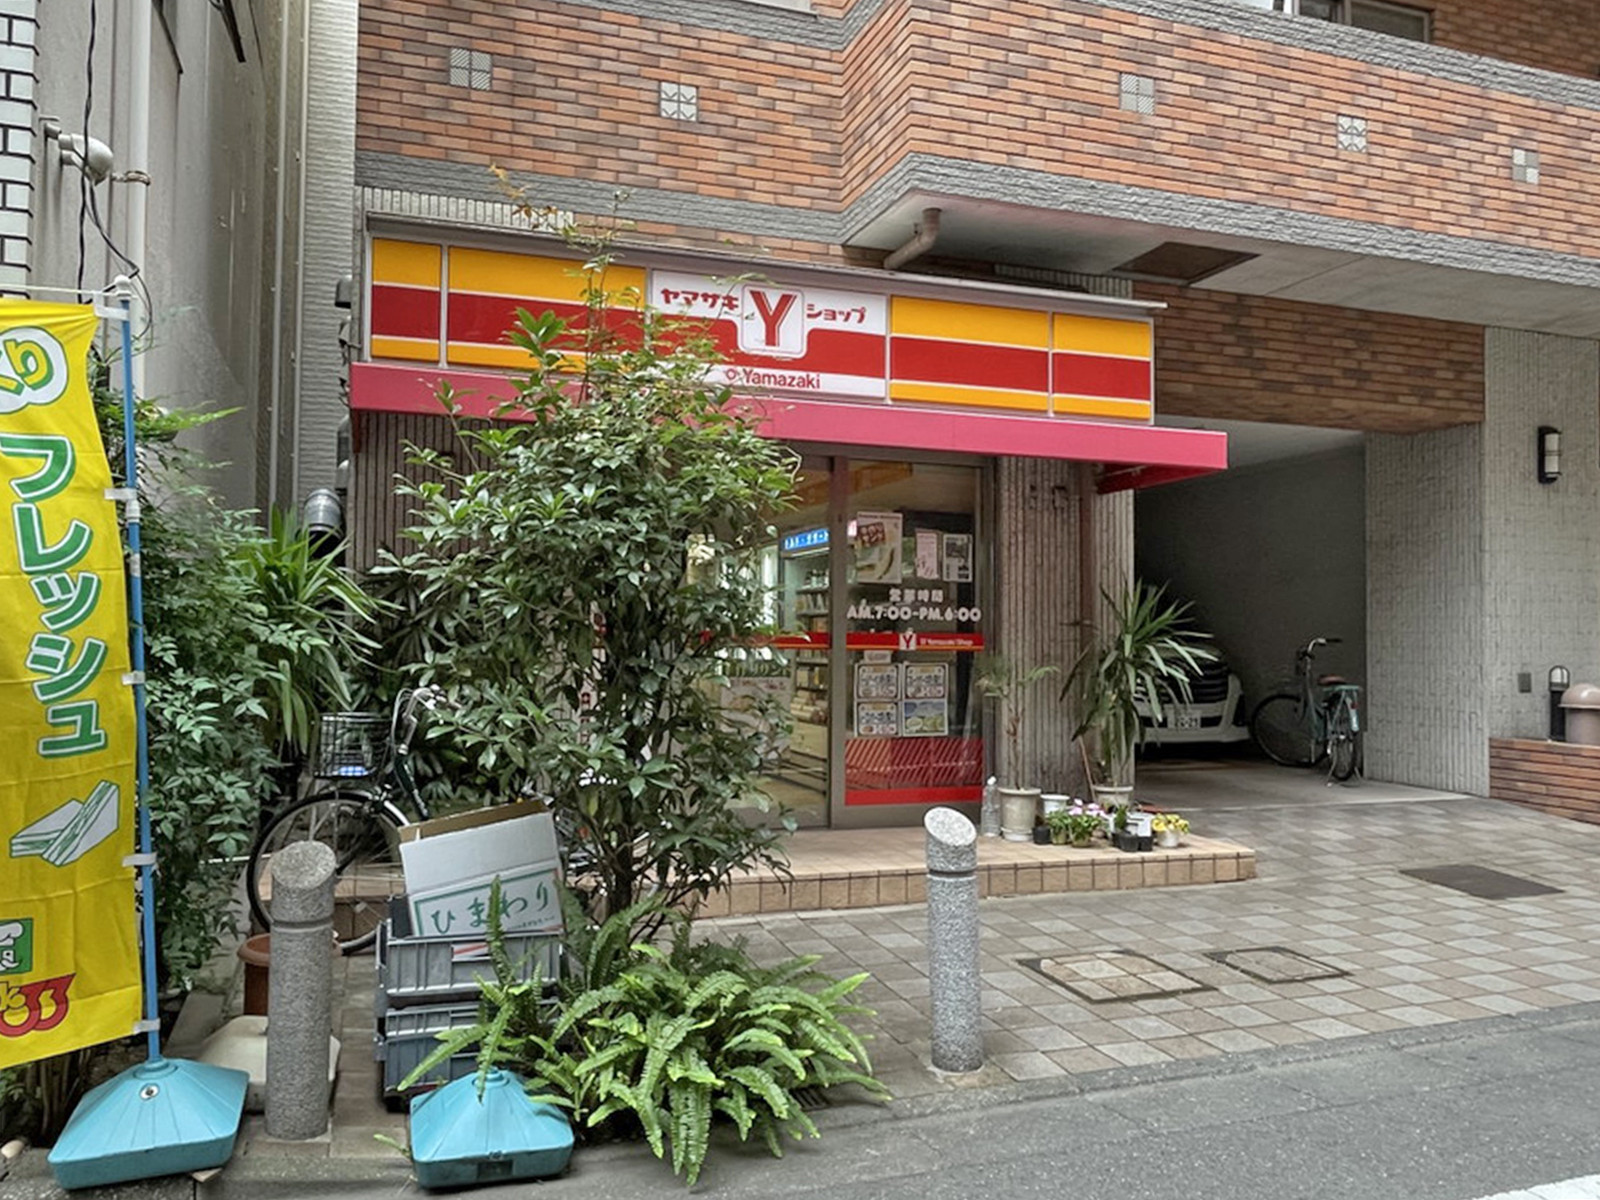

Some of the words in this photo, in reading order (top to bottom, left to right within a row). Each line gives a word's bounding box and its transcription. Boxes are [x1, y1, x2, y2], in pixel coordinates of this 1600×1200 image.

[749, 289, 798, 347] Y
[806, 303, 866, 324] ショップ
[742, 367, 820, 389] Yamazaki
[0, 433, 108, 757] フレッシュ
[431, 880, 549, 934] ひまわり
